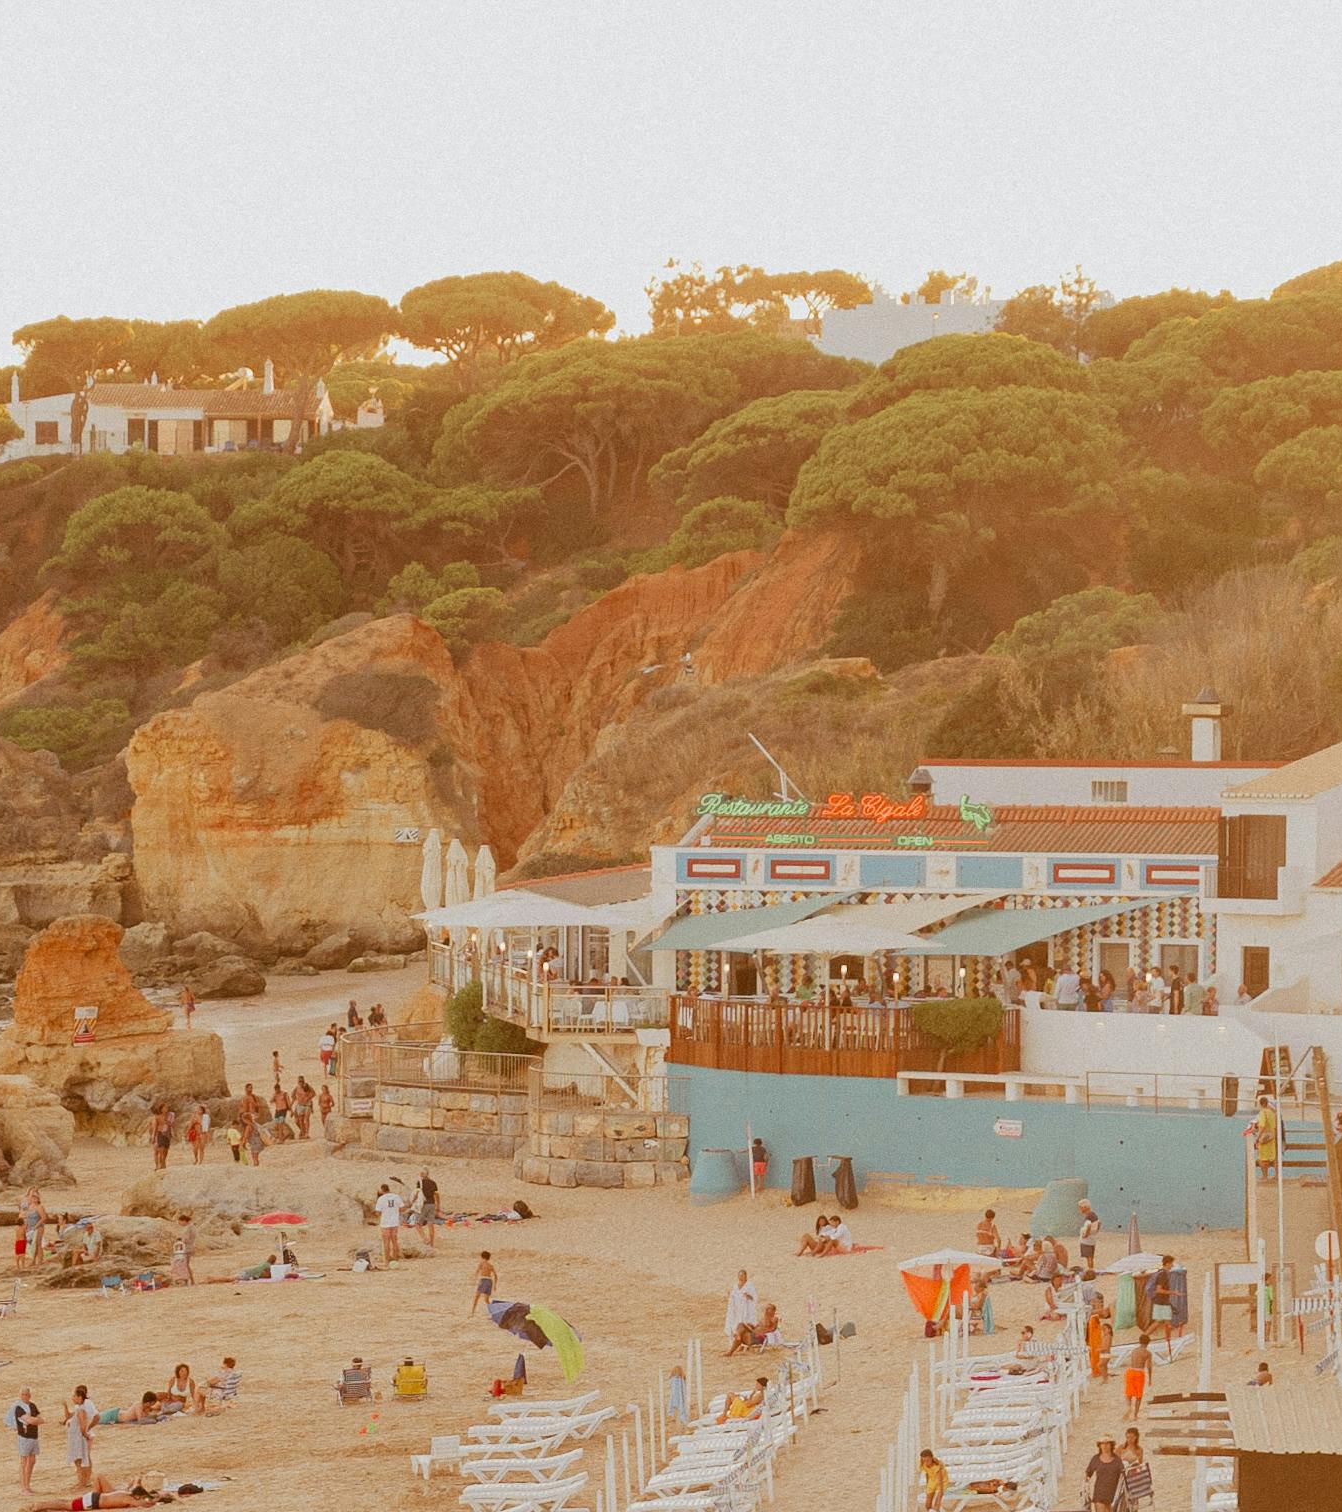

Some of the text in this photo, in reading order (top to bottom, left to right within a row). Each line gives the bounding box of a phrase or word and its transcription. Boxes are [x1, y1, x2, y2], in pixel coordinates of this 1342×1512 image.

[698, 793, 808, 817] Restaurante
[822, 794, 855, 816] La
[765, 834, 933, 846] ABERTO OPEN
